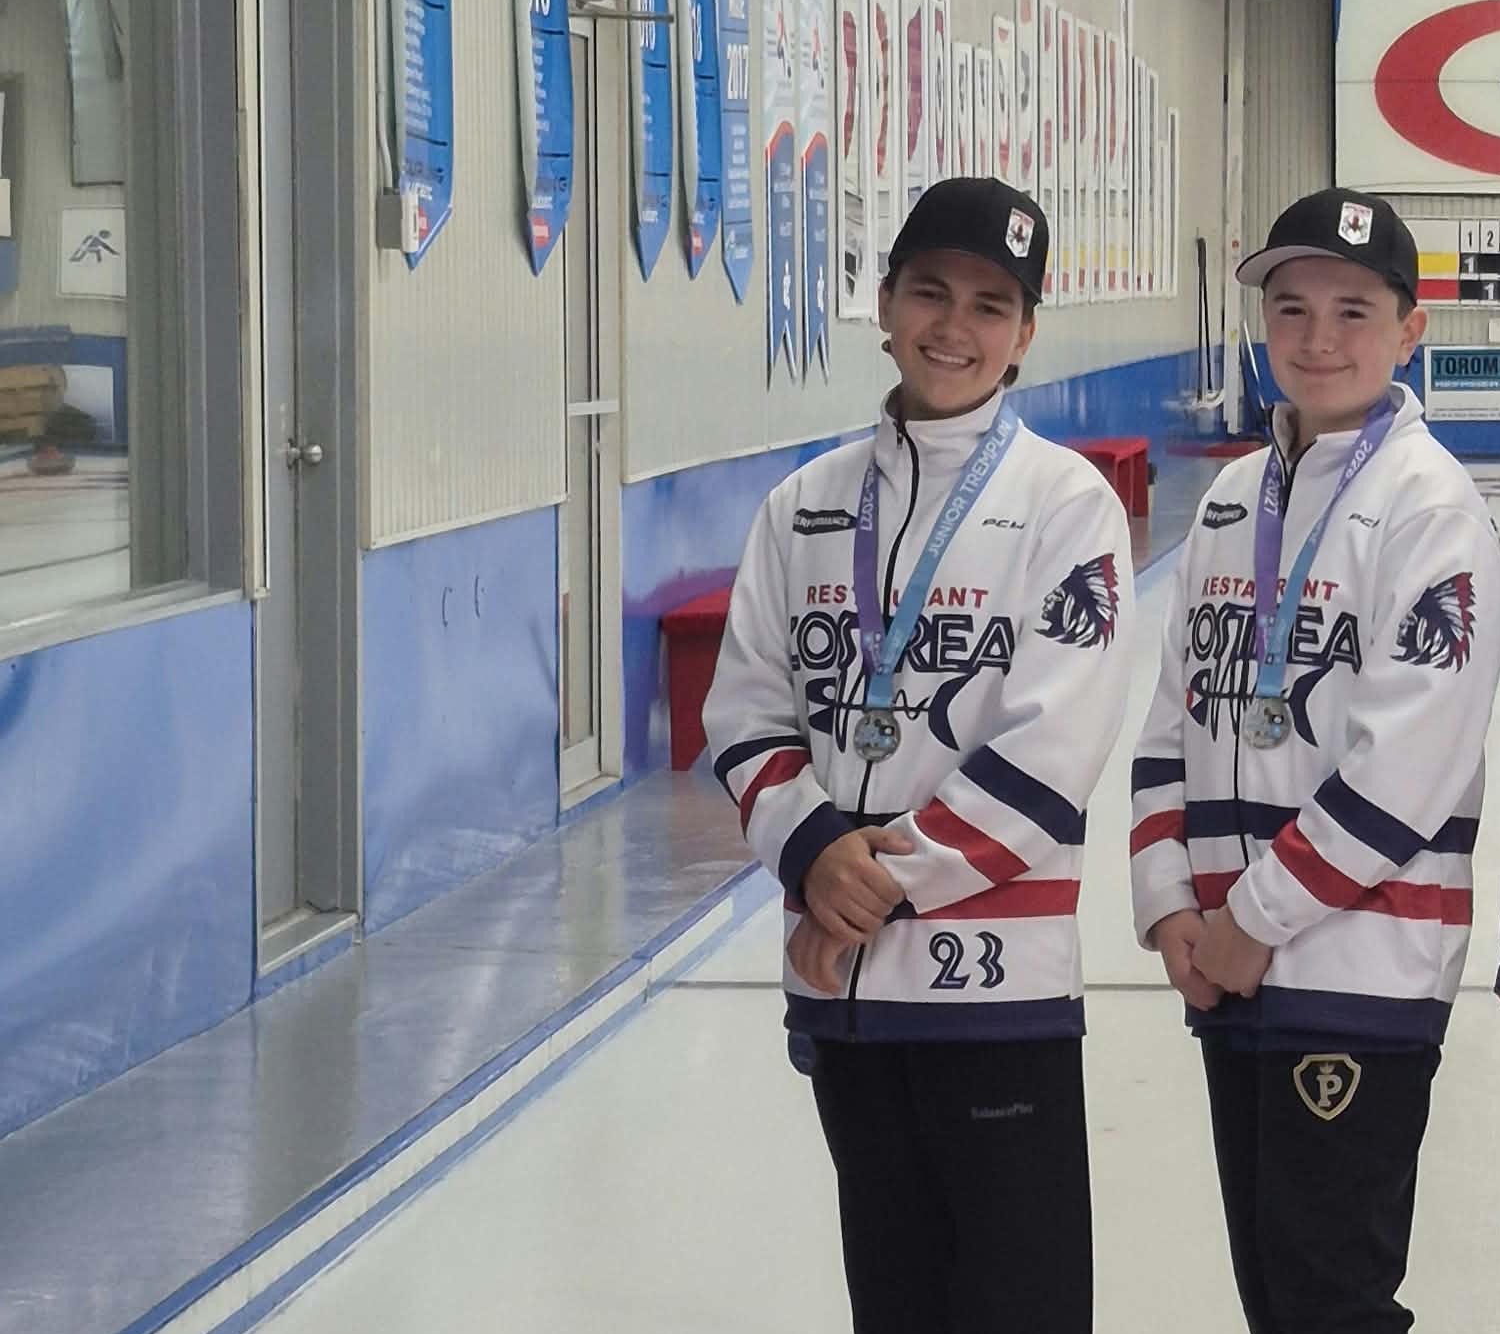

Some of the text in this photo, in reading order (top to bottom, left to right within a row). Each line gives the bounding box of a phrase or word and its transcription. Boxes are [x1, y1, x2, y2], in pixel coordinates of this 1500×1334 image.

[727, 43, 749, 99] 2017
[1467, 231, 1473, 248] 1
[1487, 231, 1494, 248] 2
[1463, 257, 1475, 273] 1
[1484, 283, 1495, 299] 1
[927, 420, 1010, 558] JUNIOR TREMPLIN
[806, 584, 989, 608] RESANT
[928, 931, 1005, 990] 23
[1316, 1075, 1342, 1108] P
